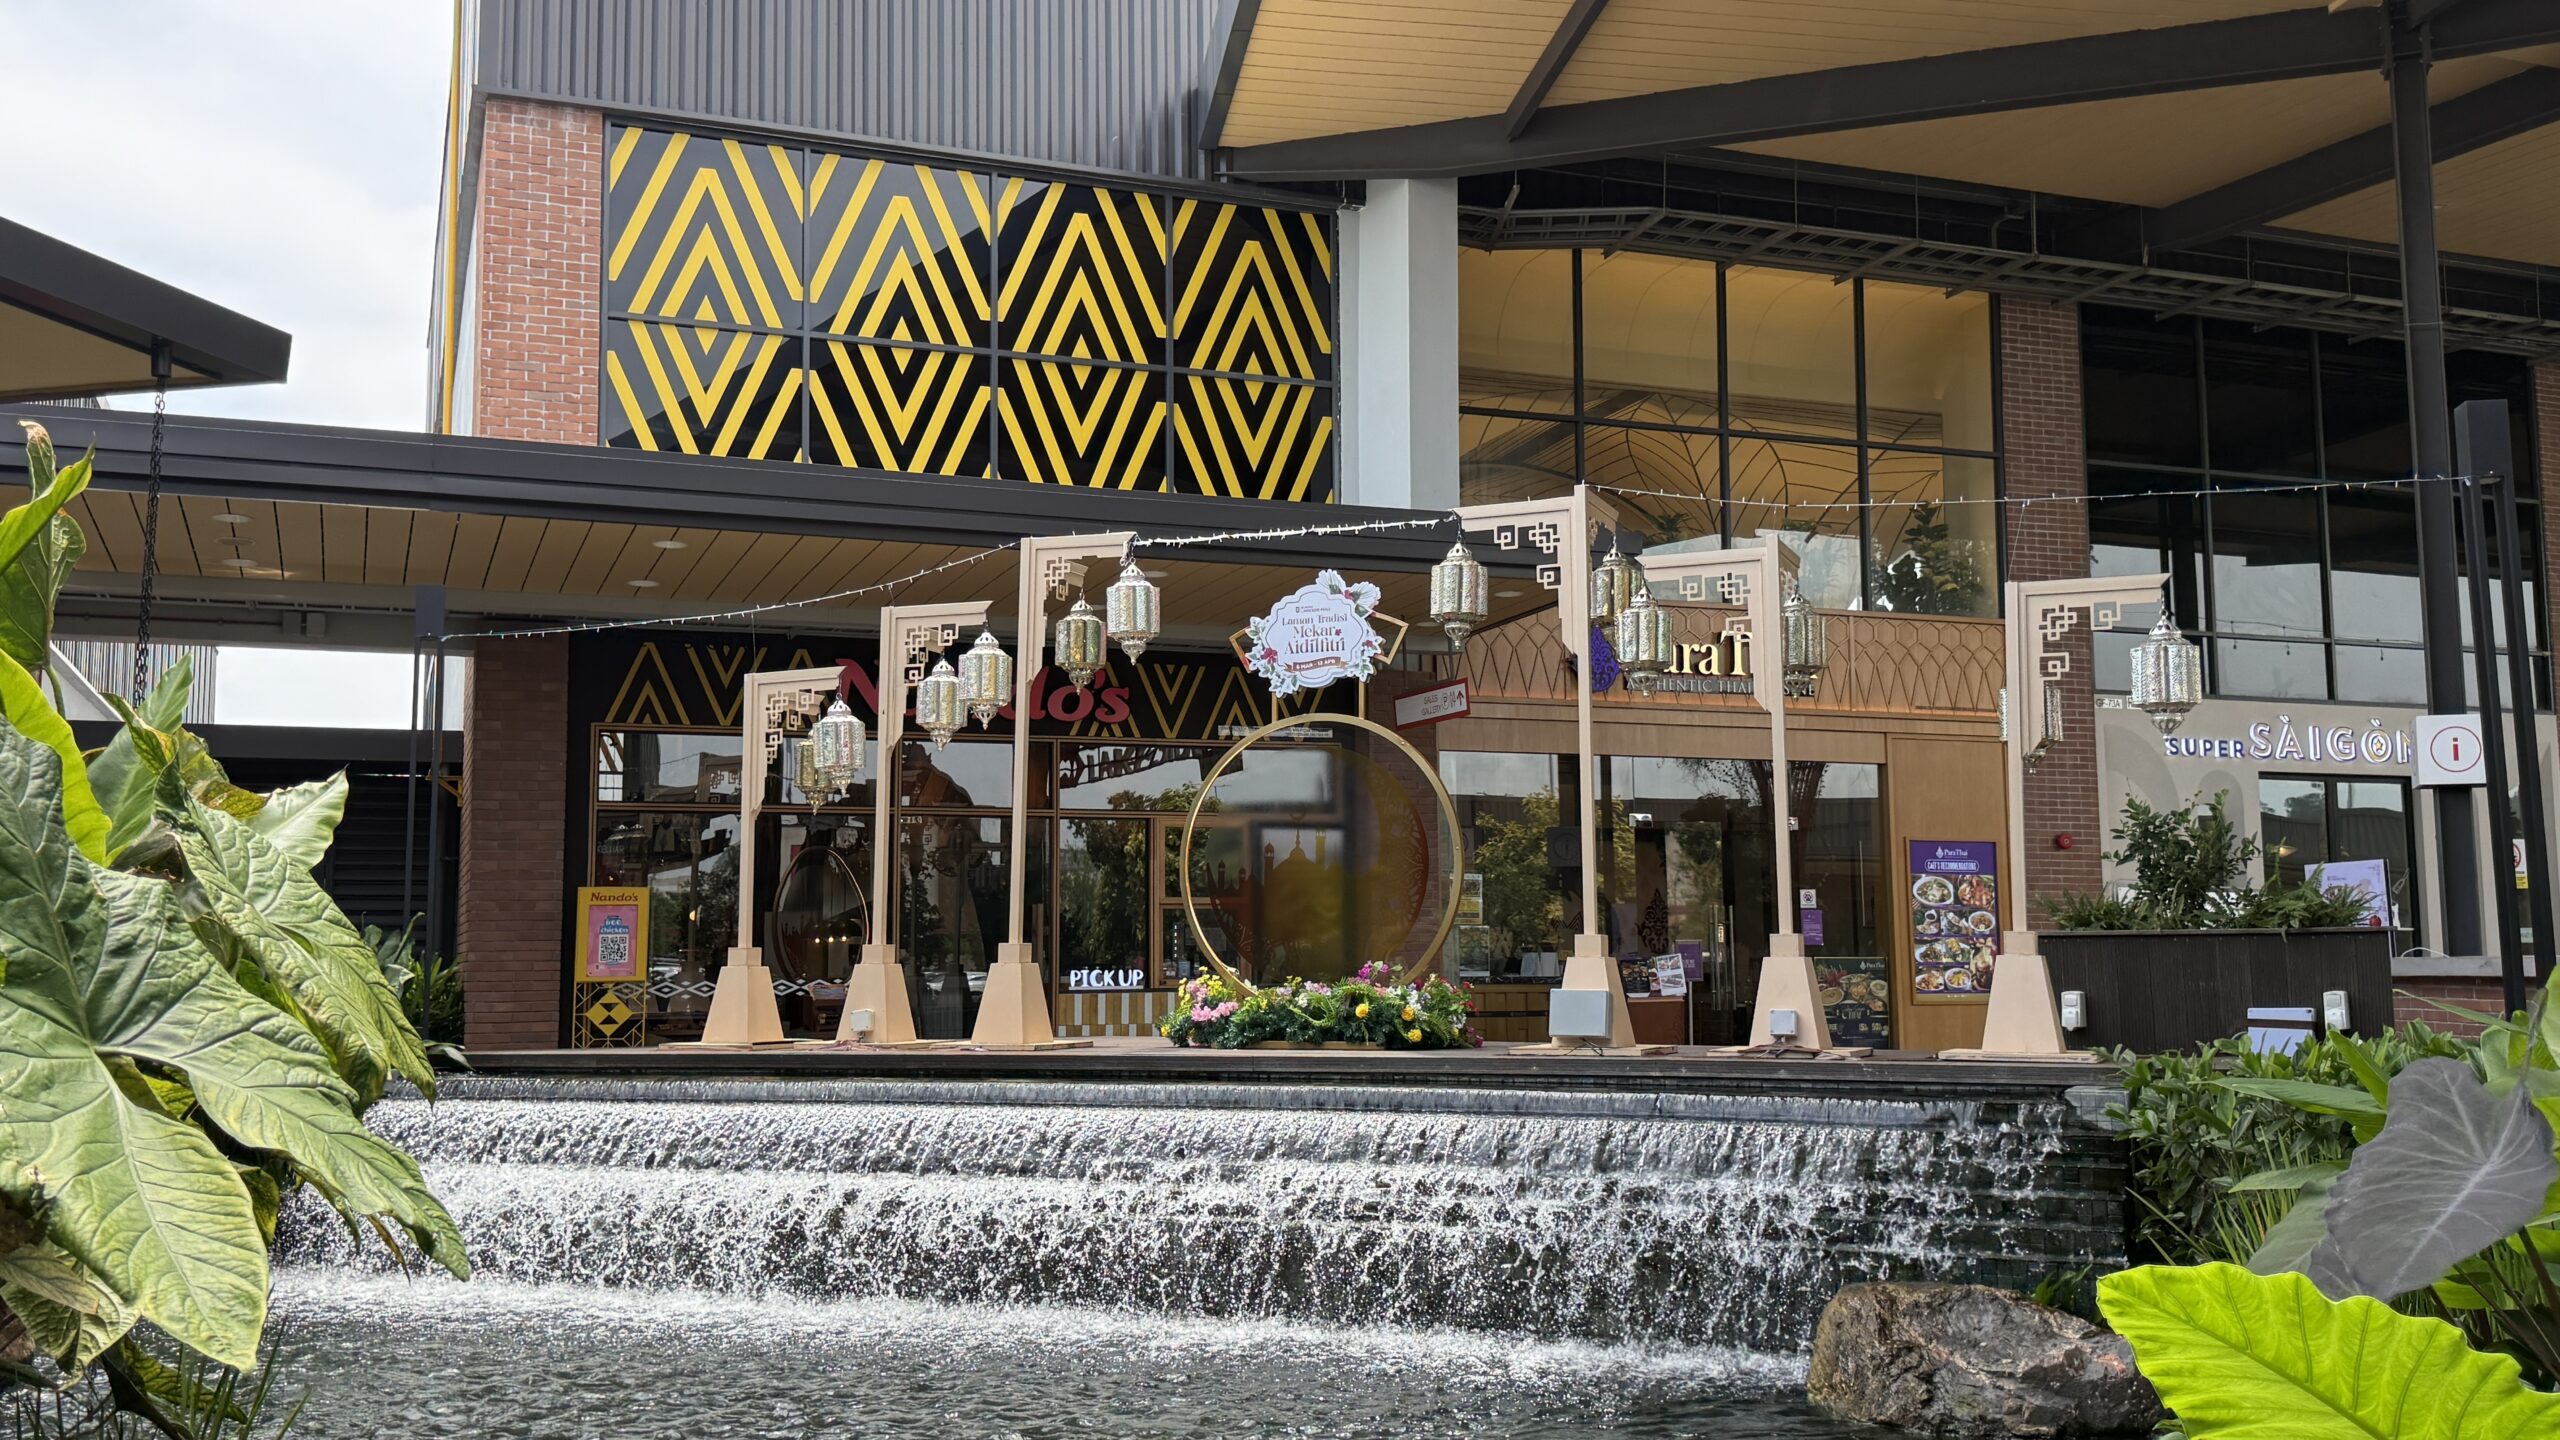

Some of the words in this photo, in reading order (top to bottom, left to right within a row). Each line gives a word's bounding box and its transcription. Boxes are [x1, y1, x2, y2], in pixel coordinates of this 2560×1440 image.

[1317, 613, 1348, 624] Tradisi
[1292, 624, 1336, 639] Mekar
[2165, 737, 2246, 759] SUPER
[590, 892, 639, 902] Nando's
[1070, 969, 1115, 988] PICK
[1118, 969, 1144, 987] UP
